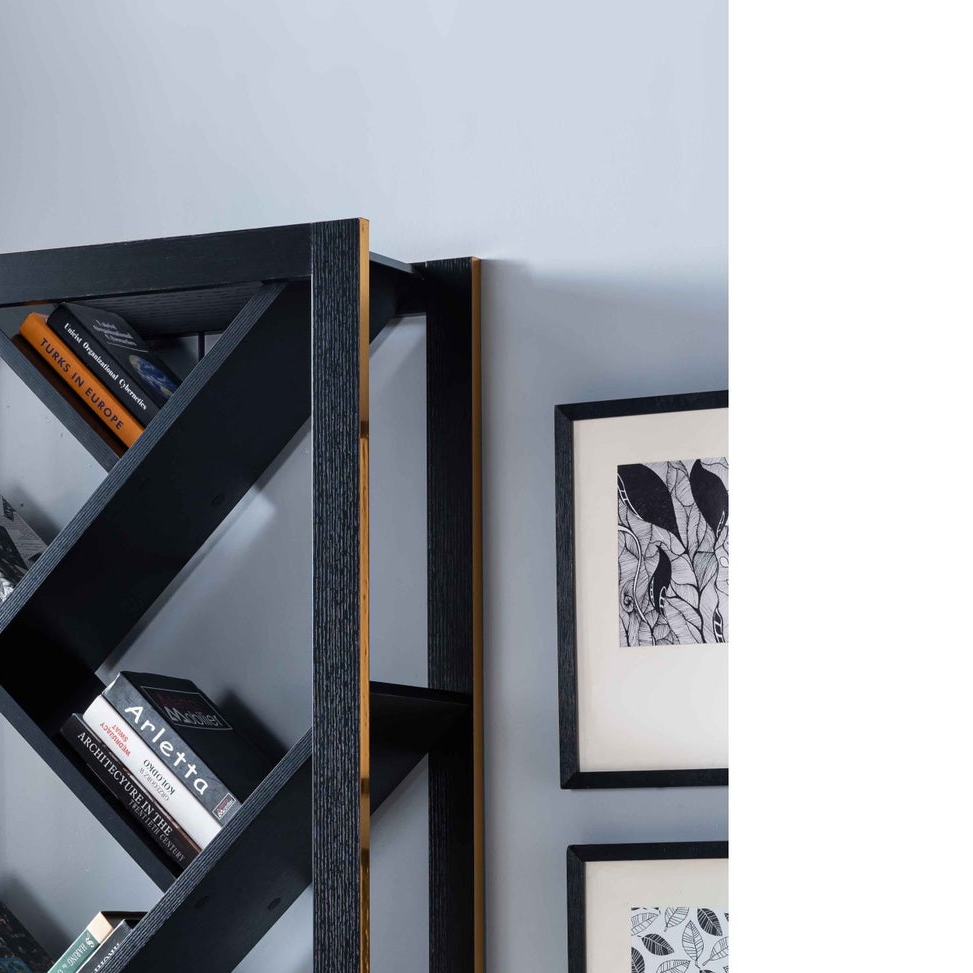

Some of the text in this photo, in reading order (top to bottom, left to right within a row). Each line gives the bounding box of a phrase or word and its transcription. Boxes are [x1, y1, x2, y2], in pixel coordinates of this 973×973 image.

[39, 337, 125, 430] TURKS IN EUROPE
[63, 322, 83, 344] Unicist
[82, 341, 119, 381] Organizational
[118, 378, 147, 411] Cybernetics
[124, 705, 211, 796] Arletta
[140, 798, 155, 816] IN
[152, 811, 174, 837] THE
[159, 831, 187, 863] CENTURY
